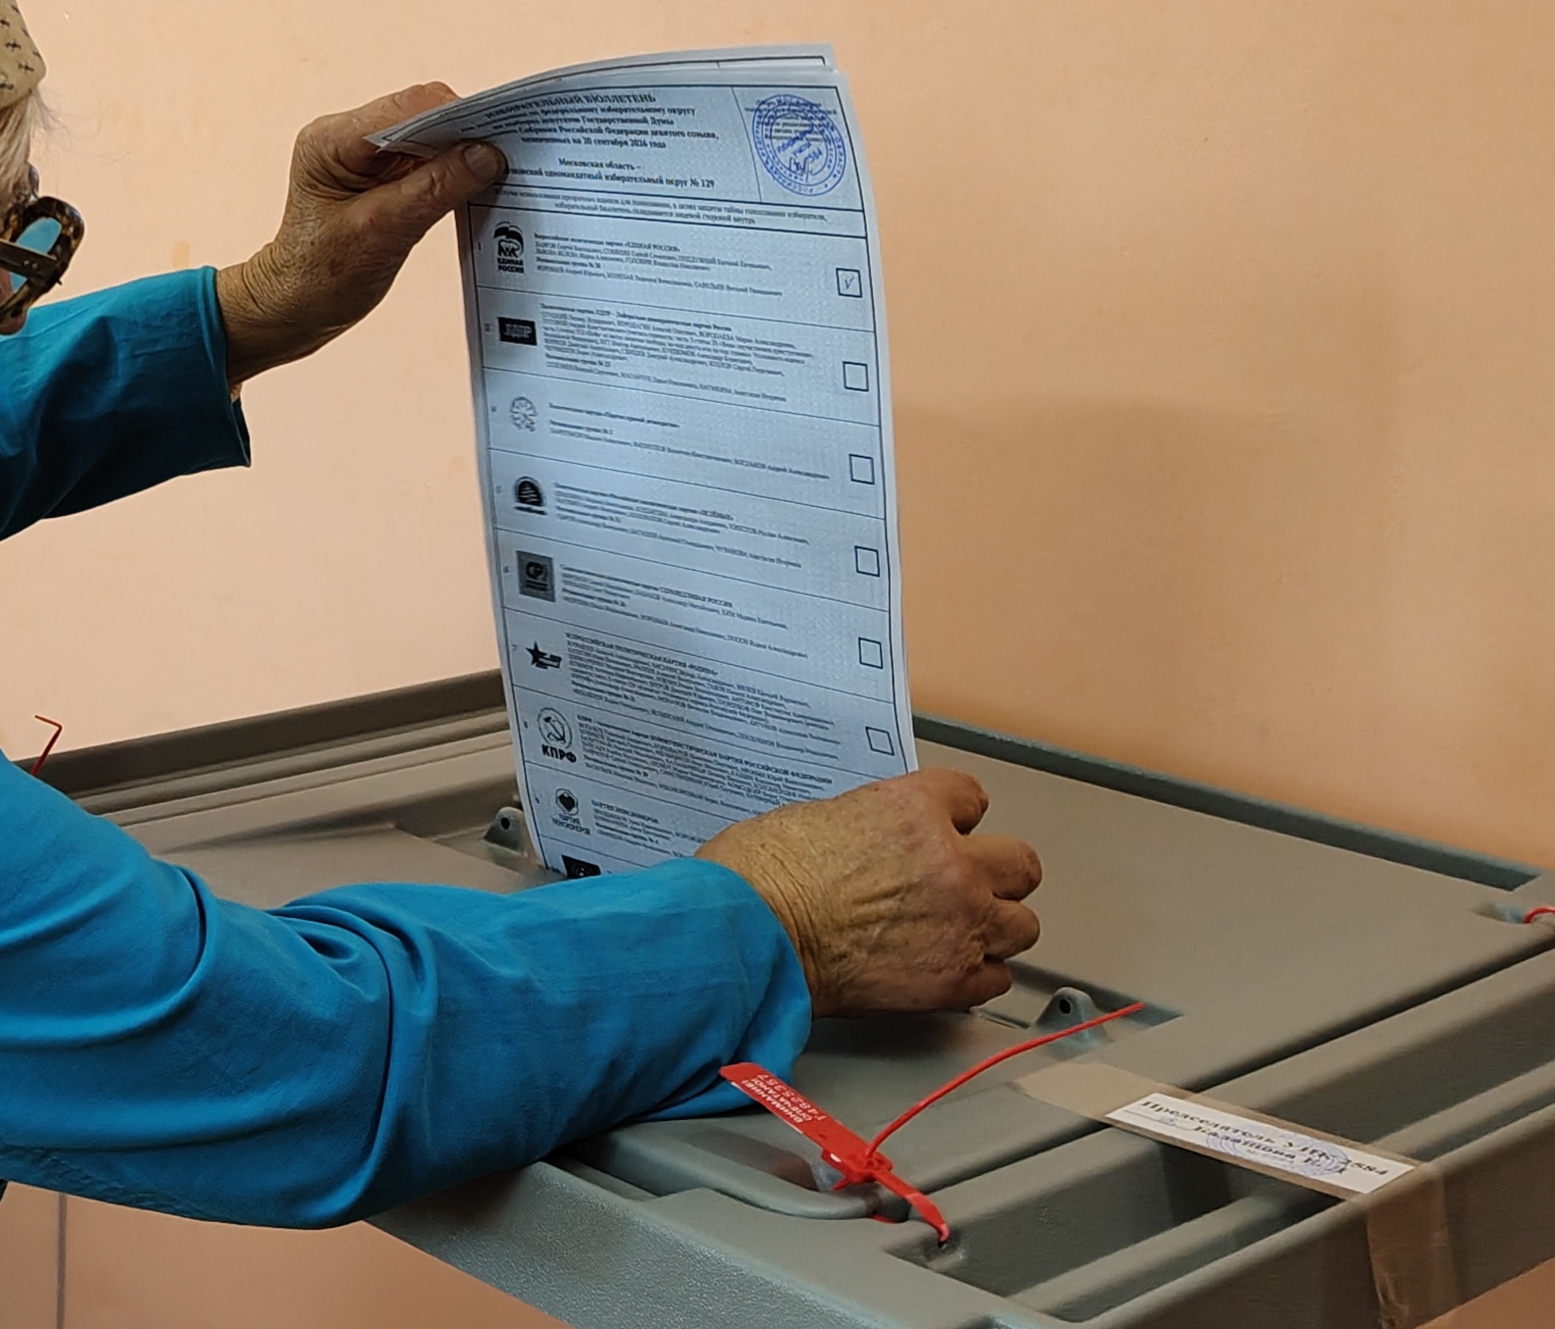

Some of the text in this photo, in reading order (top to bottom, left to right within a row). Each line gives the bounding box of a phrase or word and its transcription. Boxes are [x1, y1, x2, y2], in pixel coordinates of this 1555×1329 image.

[585, 94, 656, 104] БЮЛЛЕТЕНЬ
[558, 157, 604, 169] Московская
[605, 160, 635, 171] область
[604, 172, 664, 184] избирательный
[665, 178, 689, 188] округ
[701, 178, 715, 189] 129
[541, 743, 577, 764] КПРФ
